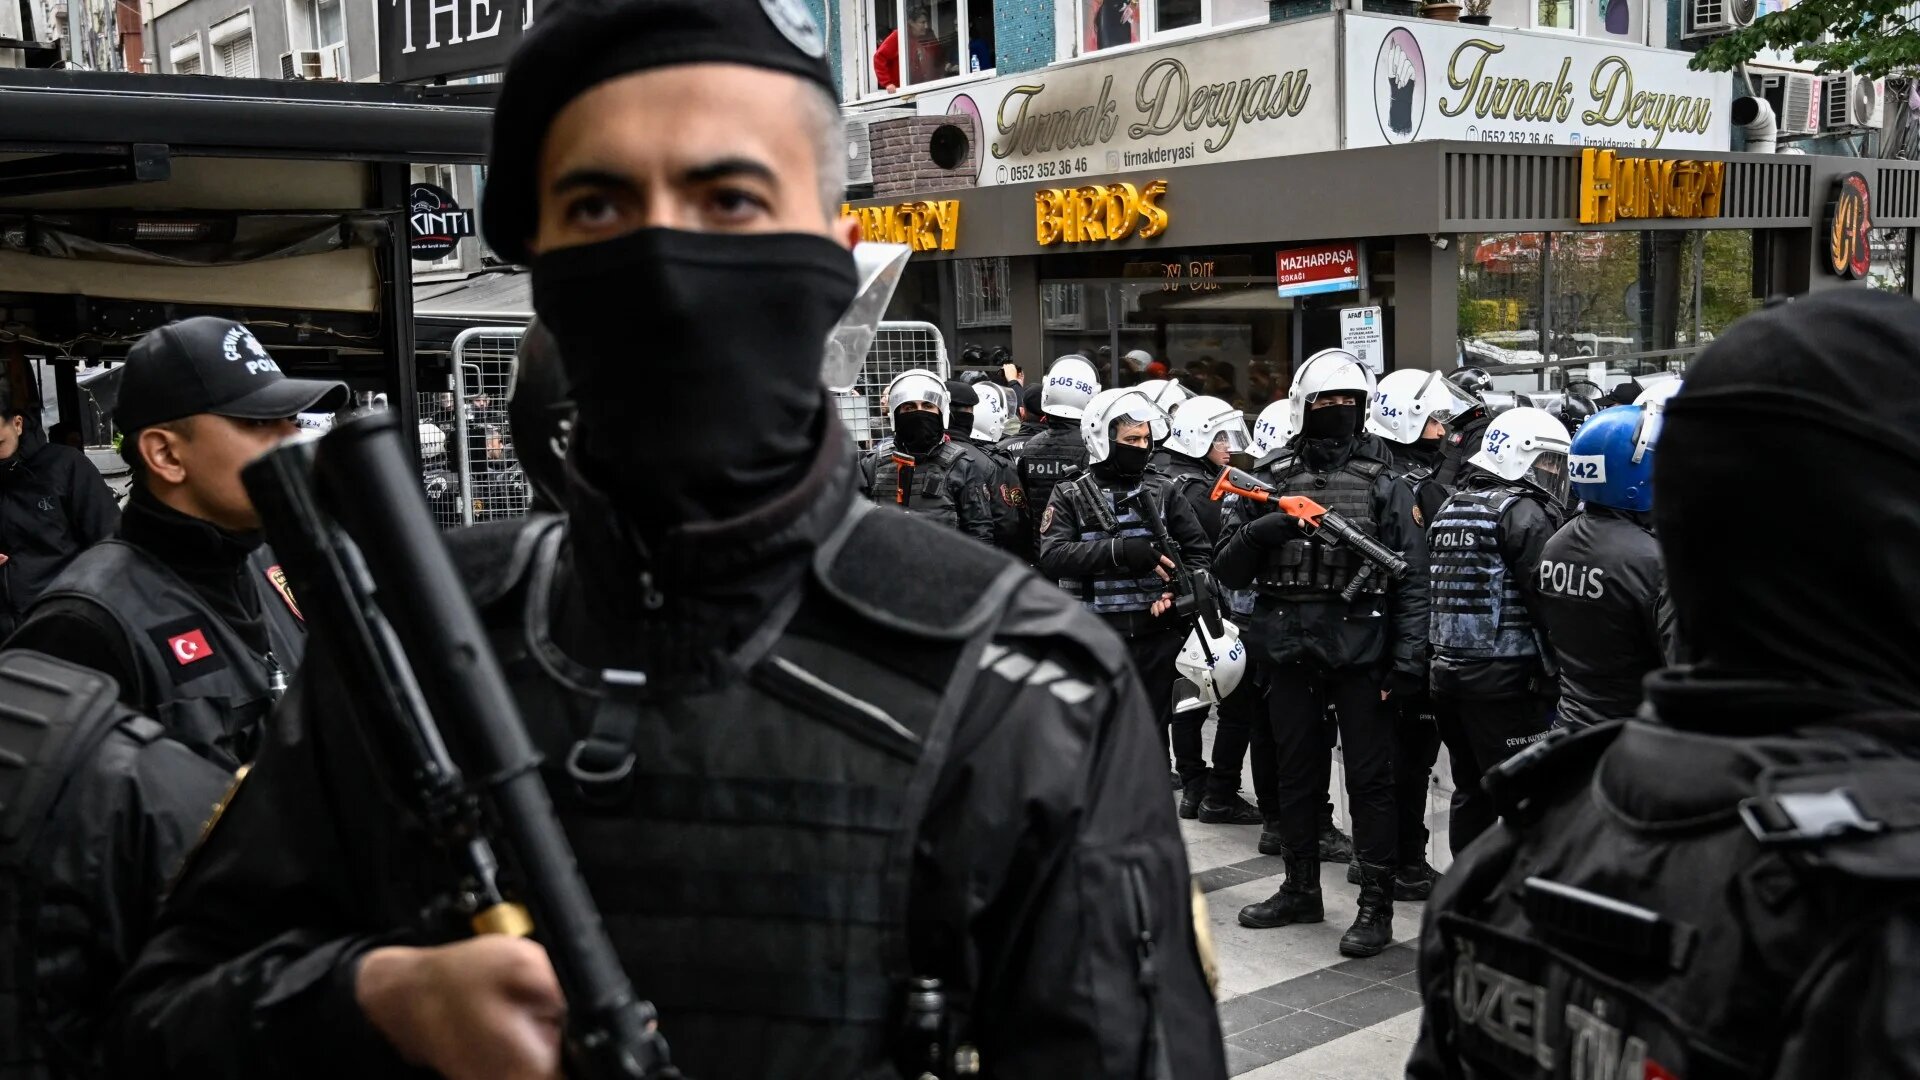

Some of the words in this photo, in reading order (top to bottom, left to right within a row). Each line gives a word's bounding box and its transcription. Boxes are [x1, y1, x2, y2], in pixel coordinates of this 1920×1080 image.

[389, 0, 503, 54] THE
[1809, 80, 1820, 129] VESTEL
[1123, 142, 1195, 168] tirnakderyasi
[1010, 164, 1035, 182] 0552
[1037, 161, 1056, 179] 352
[1058, 159, 1072, 176] 36
[1074, 157, 1088, 174] 46
[1579, 147, 1725, 225] HUNGRY
[1035, 180, 1169, 247] BIRDS
[1280, 249, 1354, 271] MAZHARPAŞA
[1280, 272, 1305, 283] SOKAĞI
[1347, 311, 1363, 319] AFAD
[1075, 380, 1093, 396] 585
[1381, 406, 1397, 418] 34
[1172, 427, 1182, 437] 34
[1257, 437, 1267, 450] 34
[1486, 441, 1500, 455] 34
[1568, 461, 1599, 479] 242
